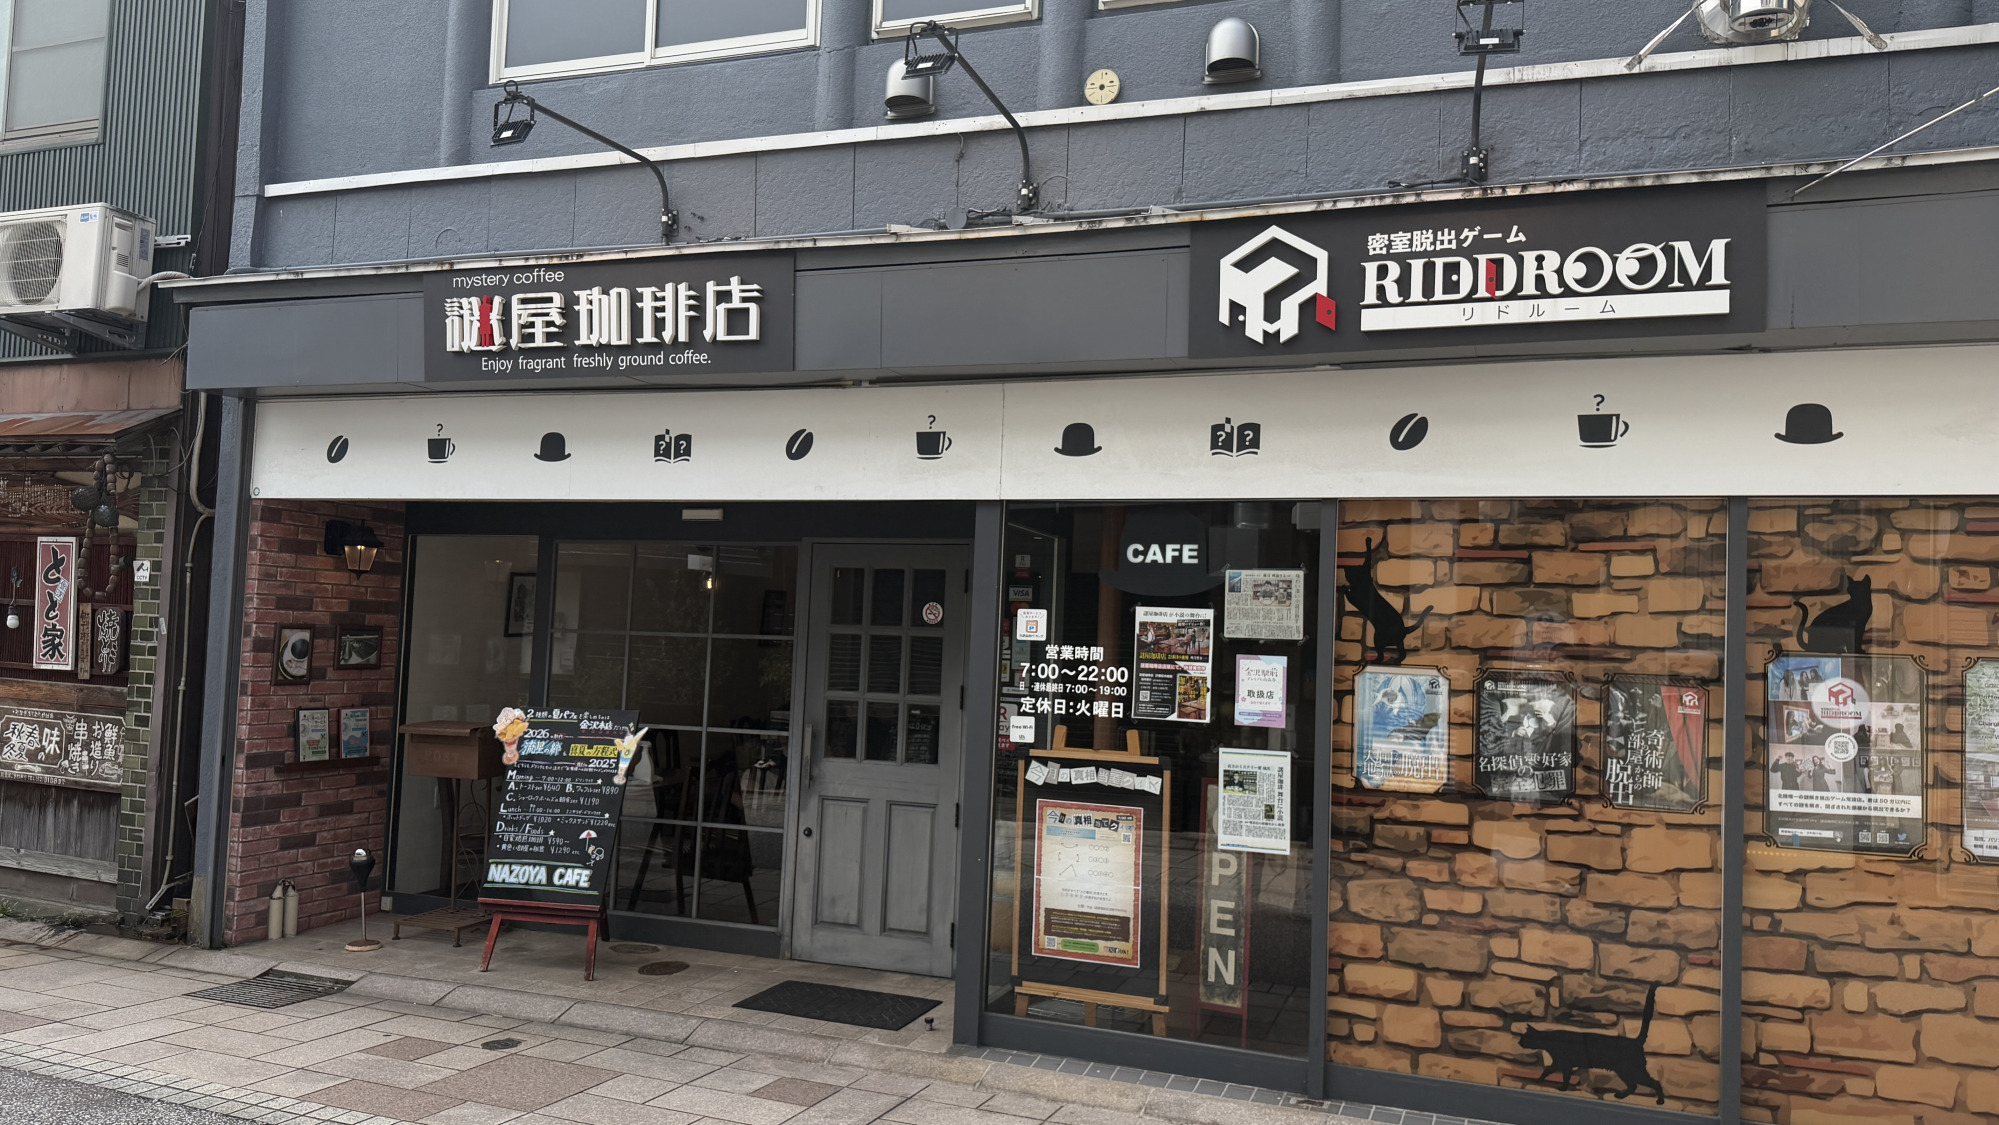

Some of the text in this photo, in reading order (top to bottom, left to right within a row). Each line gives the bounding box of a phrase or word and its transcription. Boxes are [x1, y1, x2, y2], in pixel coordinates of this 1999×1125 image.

[1366, 225, 1527, 255] 密室脱出ゲーム
[452, 269, 566, 289] mystery coffee
[1359, 238, 1732, 307] RIDDROOM
[444, 275, 764, 354] 謎屋珈琲店
[1461, 299, 1617, 322] リドルーム
[481, 349, 712, 374] Enjoy fragrant freshly ground coffee.
[1126, 543, 1199, 564] CAFE
[41, 545, 66, 661] とと家
[1013, 589, 1030, 597] VISA
[1045, 644, 1104, 662] 営業時間
[1020, 662, 1129, 683] 7:00〜22:00
[1065, 684, 1127, 697] 7:00〜19:00
[1246, 689, 1275, 700] 取扱店
[1020, 696, 1124, 718] 定休日：火曜日
[506, 769, 533, 781] Morning
[1605, 757, 1635, 806] 脱出
[505, 792, 516, 802] C.
[507, 781, 519, 791] A.
[543, 783, 561, 791] ¥640
[565, 784, 575, 793] B.
[499, 803, 522, 813] Lunch
[550, 845, 571, 855] ¥1290
[486, 863, 593, 888] NAZOYA CAFE
